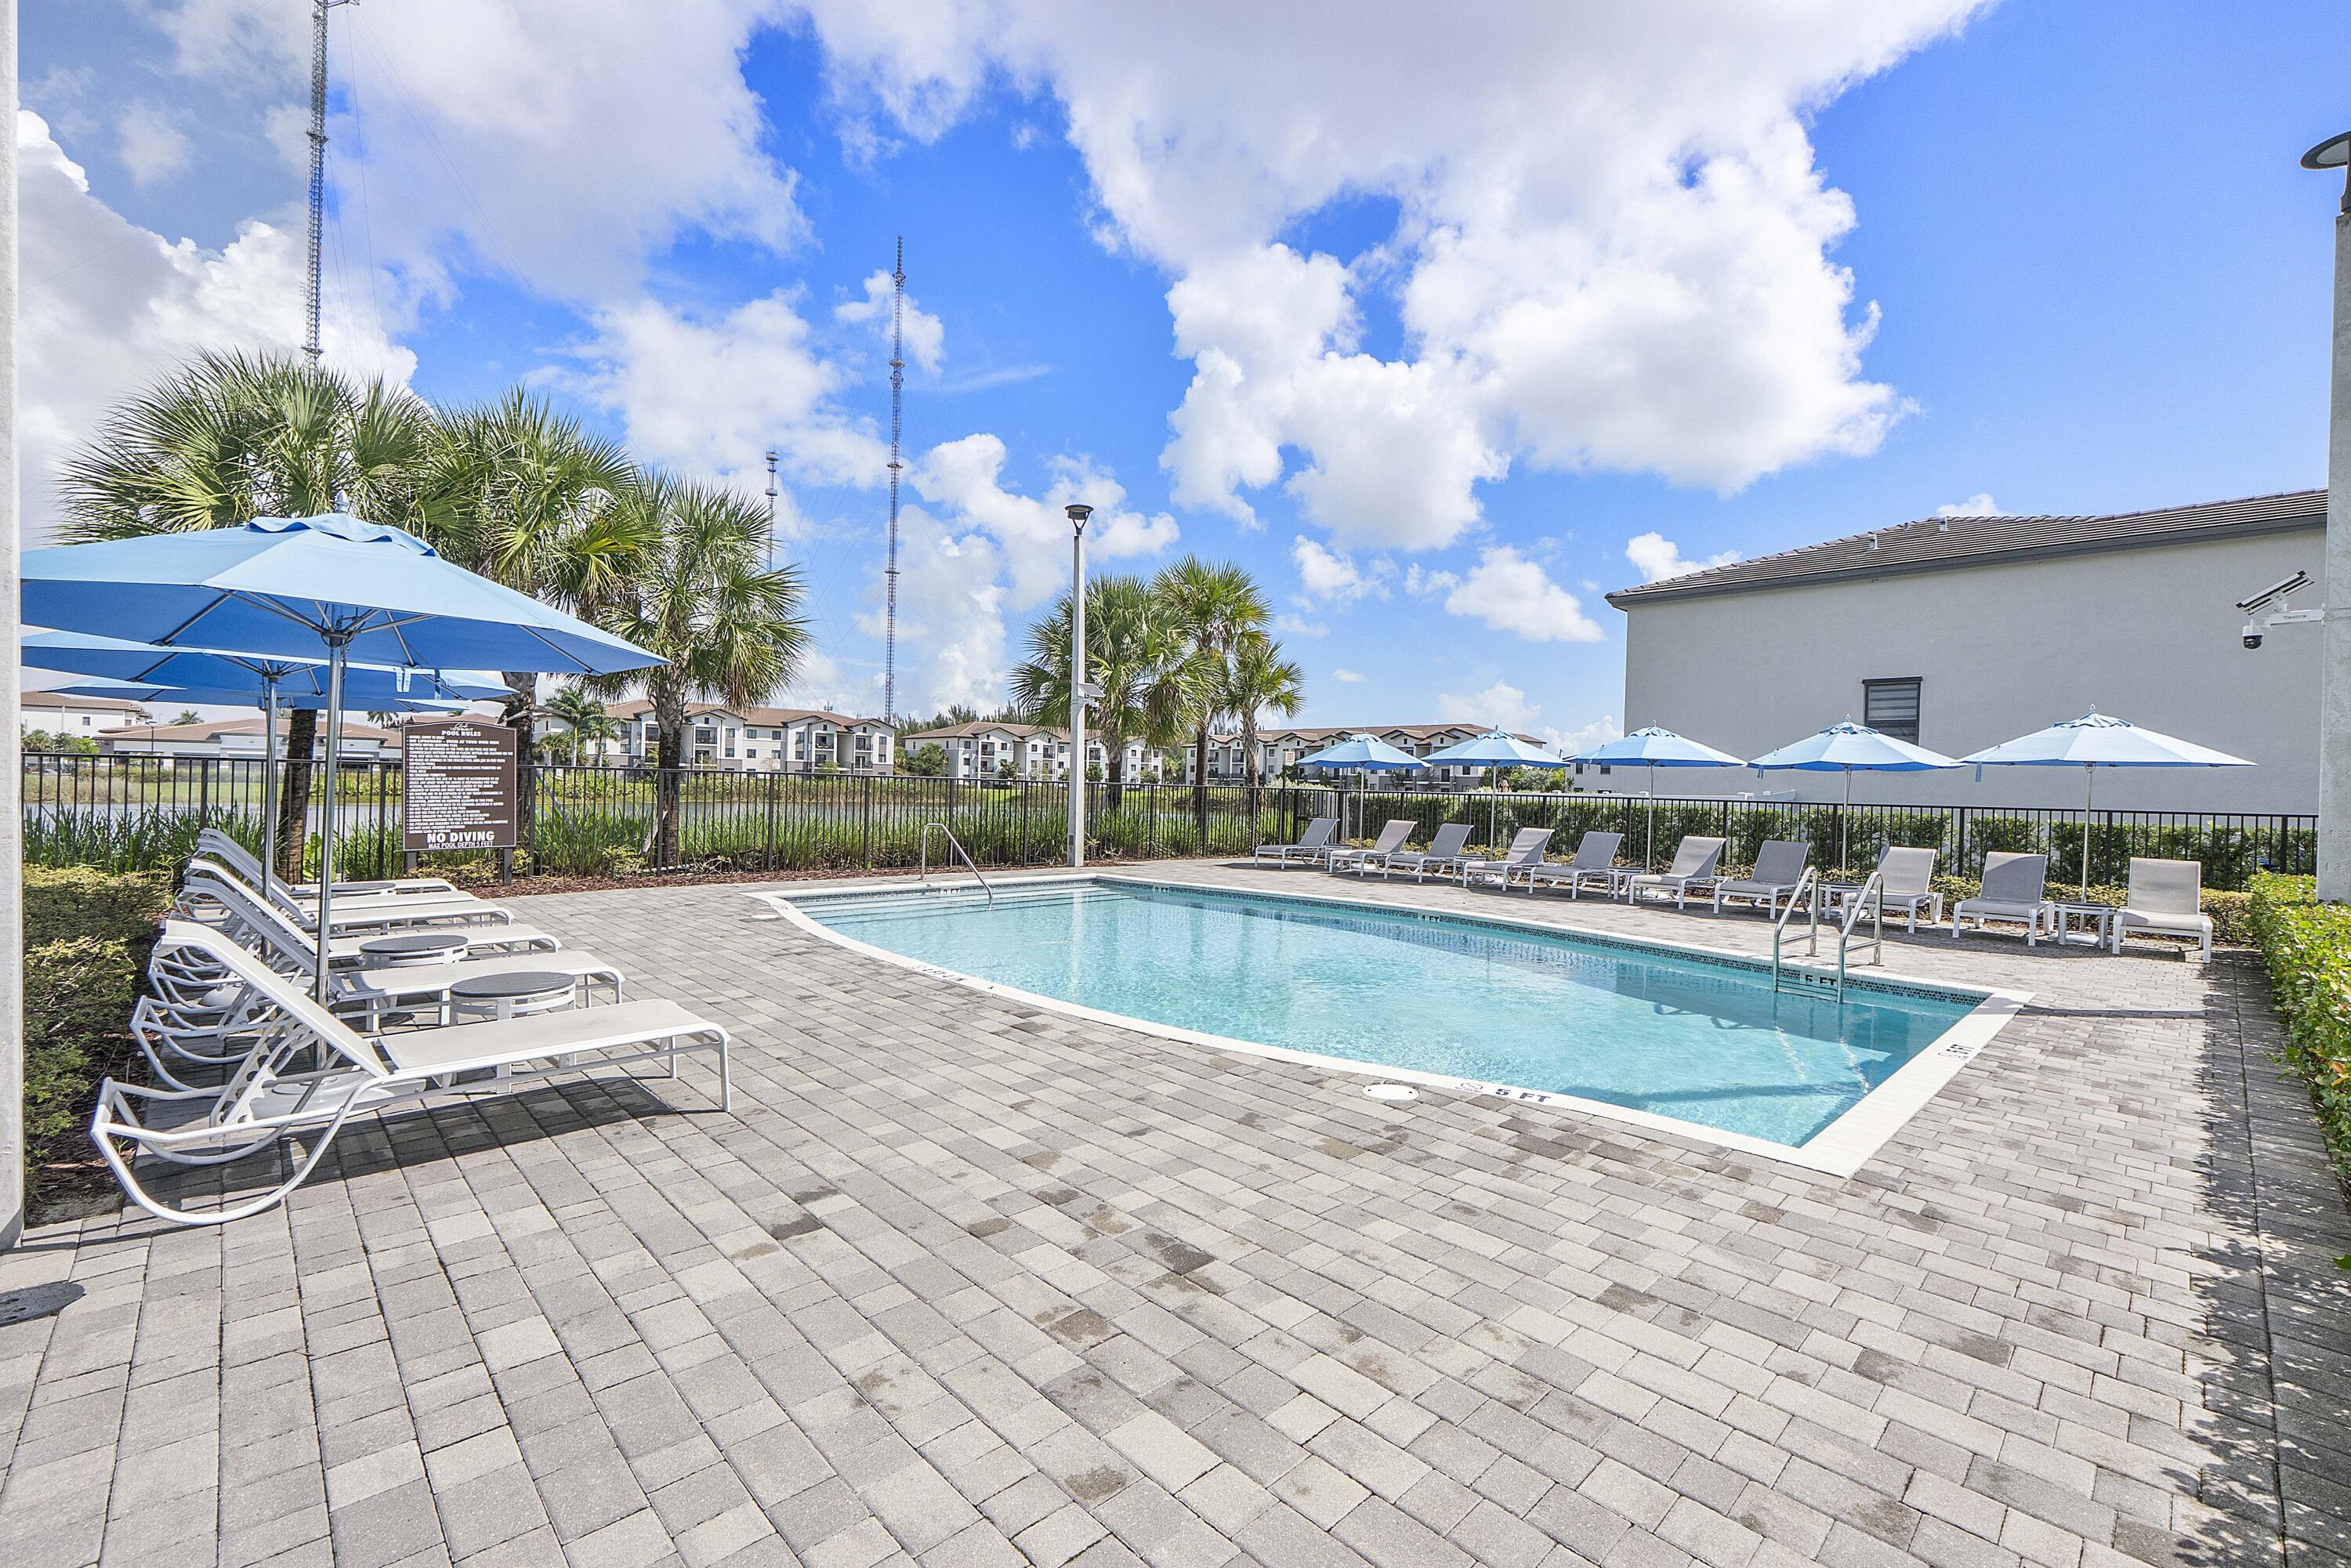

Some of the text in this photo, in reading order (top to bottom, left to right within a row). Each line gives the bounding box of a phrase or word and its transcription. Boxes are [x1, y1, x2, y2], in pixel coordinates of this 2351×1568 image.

[427, 833, 446, 843] NO
[450, 831, 494, 842] DIVING
[1820, 977, 1837, 985] FT
[1519, 1093, 1551, 1102] FT
